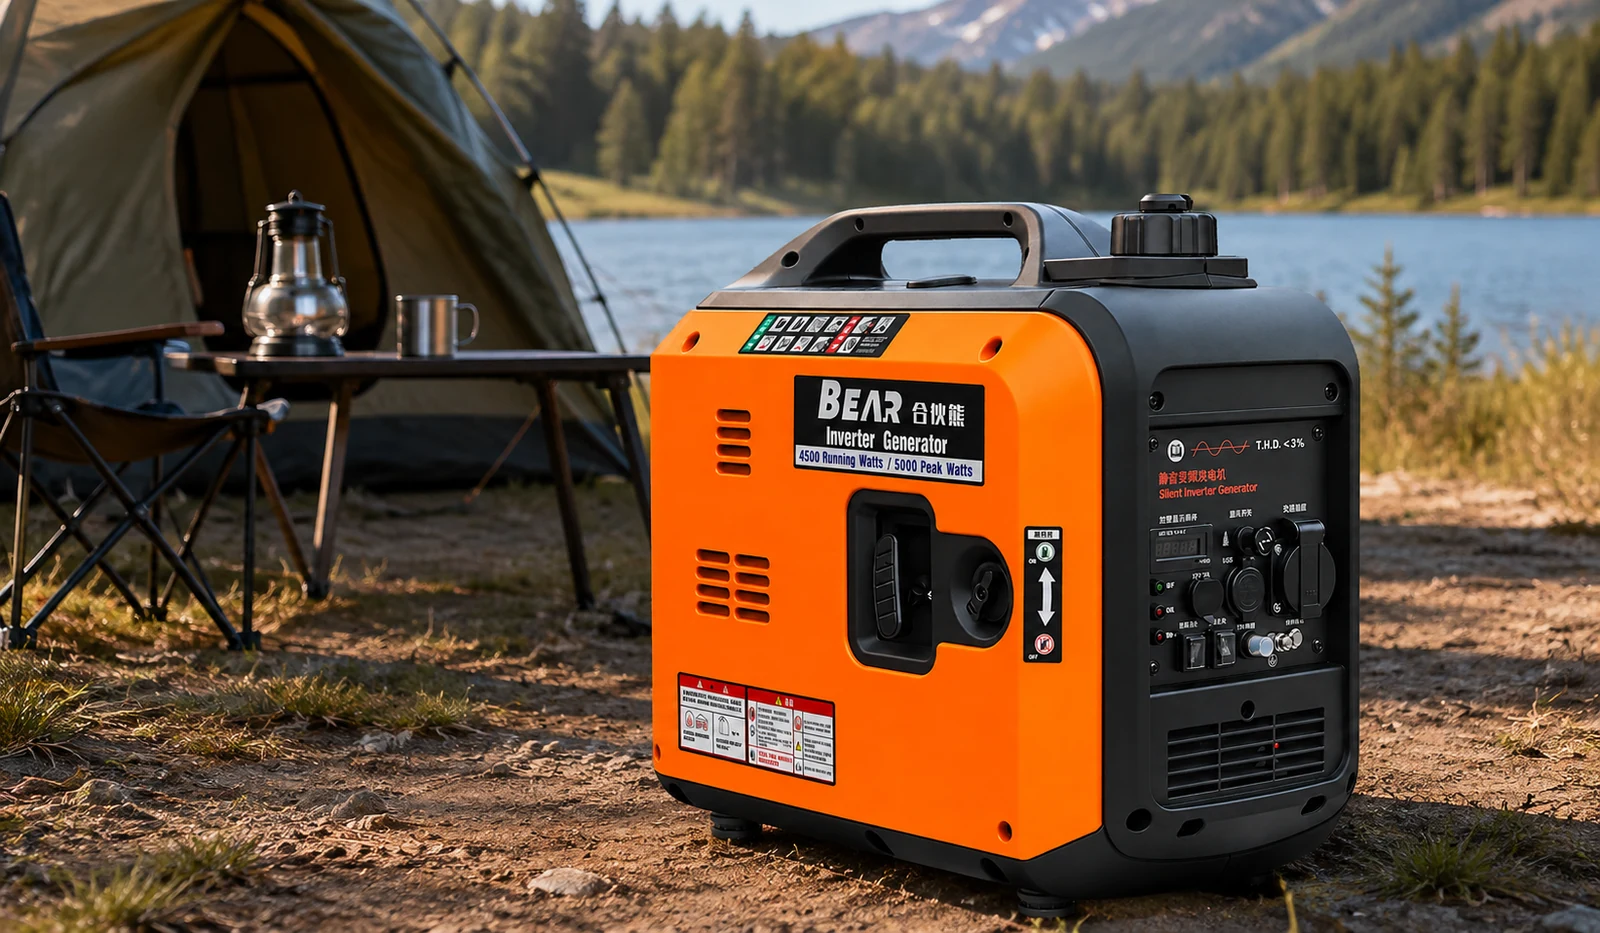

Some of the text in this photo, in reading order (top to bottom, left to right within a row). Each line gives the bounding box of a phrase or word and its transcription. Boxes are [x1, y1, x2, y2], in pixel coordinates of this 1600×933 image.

[818, 379, 903, 423] BEAR
[912, 402, 965, 427] 合伙熊
[826, 426, 948, 454] Inverter Generator
[1256, 439, 1281, 450] T.H.D.
[799, 449, 820, 463] 4500
[822, 451, 856, 469] Running
[859, 454, 883, 469] Watts
[894, 458, 918, 472] 5000
[920, 460, 943, 475] Peak
[946, 462, 973, 477] Watts
[1159, 483, 1258, 499] Silent Inverter Generator
